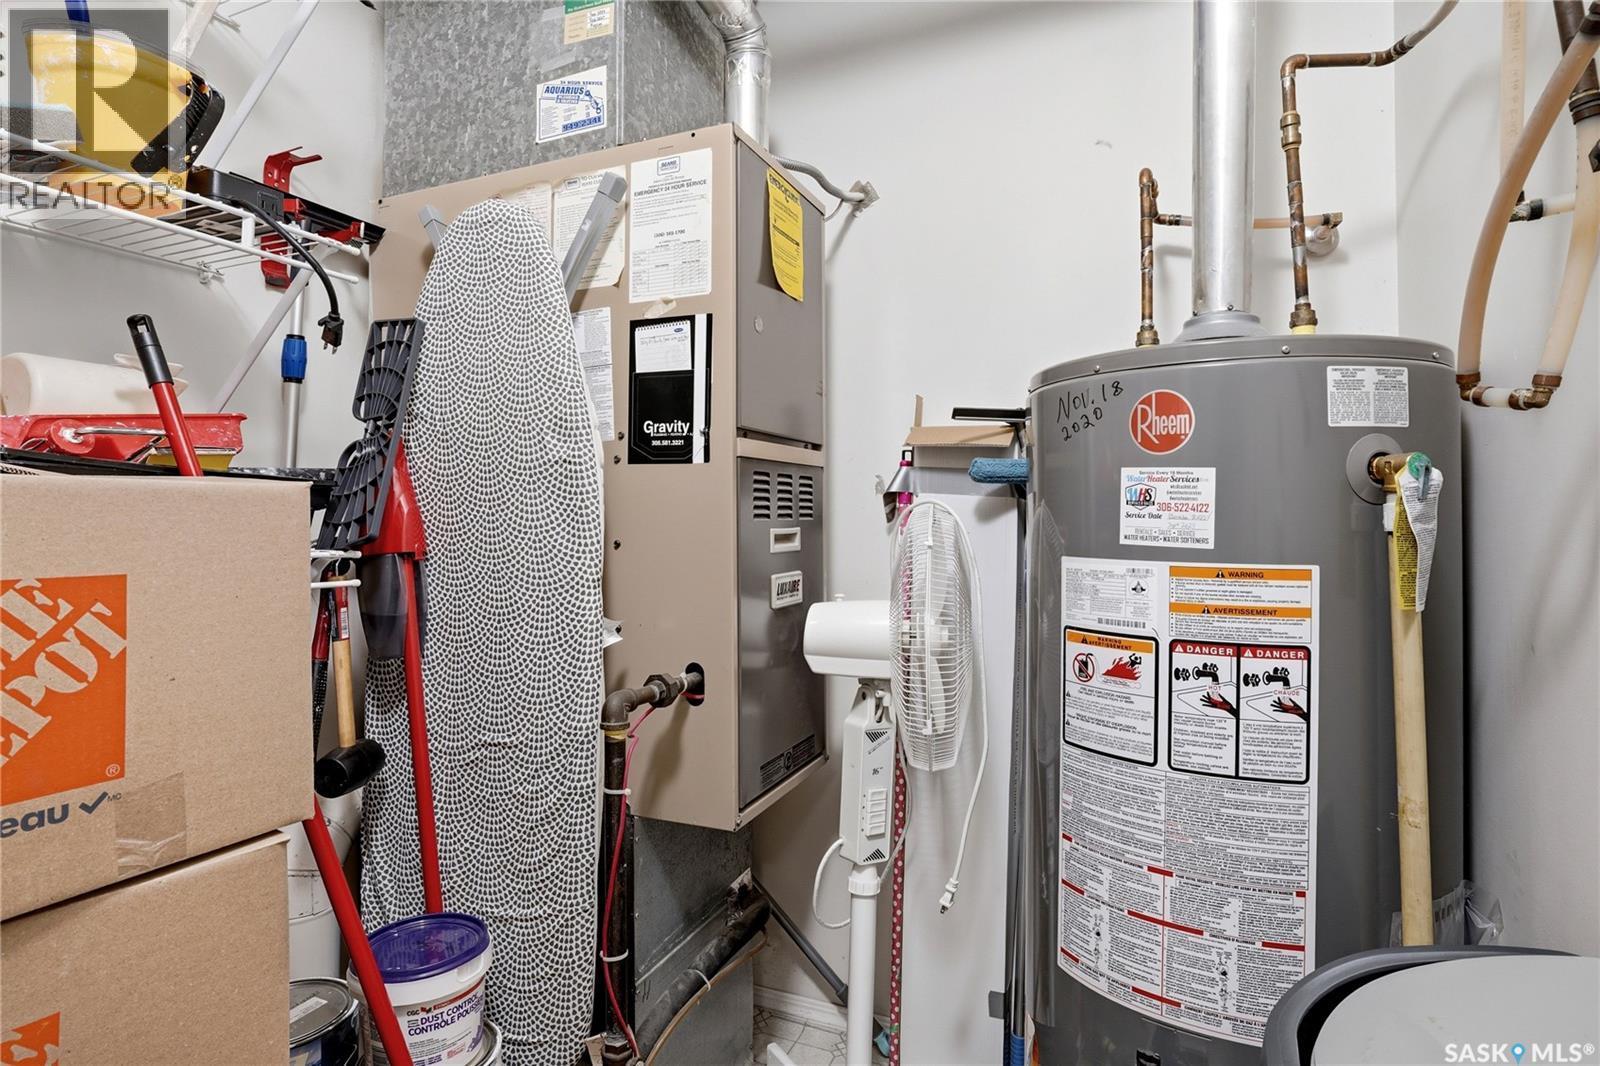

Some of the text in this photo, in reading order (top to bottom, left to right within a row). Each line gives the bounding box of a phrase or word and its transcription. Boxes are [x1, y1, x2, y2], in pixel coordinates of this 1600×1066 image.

[544, 86, 585, 95] AQUARIUS
[1102, 380, 1124, 402] 18
[1137, 392, 1190, 444] Rheem
[643, 419, 690, 437] Gravity
[1061, 407, 1103, 442] 2020
[1126, 475, 1200, 483] Water Heater Services
[1156, 502, 1210, 513] 306-522-4122
[1213, 607, 1278, 616] AVERTISSEMENT
[1186, 645, 1234, 656] DANGER
[1256, 649, 1305, 659] DANGER
[406, 1009, 420, 1017] CGC
[420, 991, 479, 1025] DUST CONTROL
